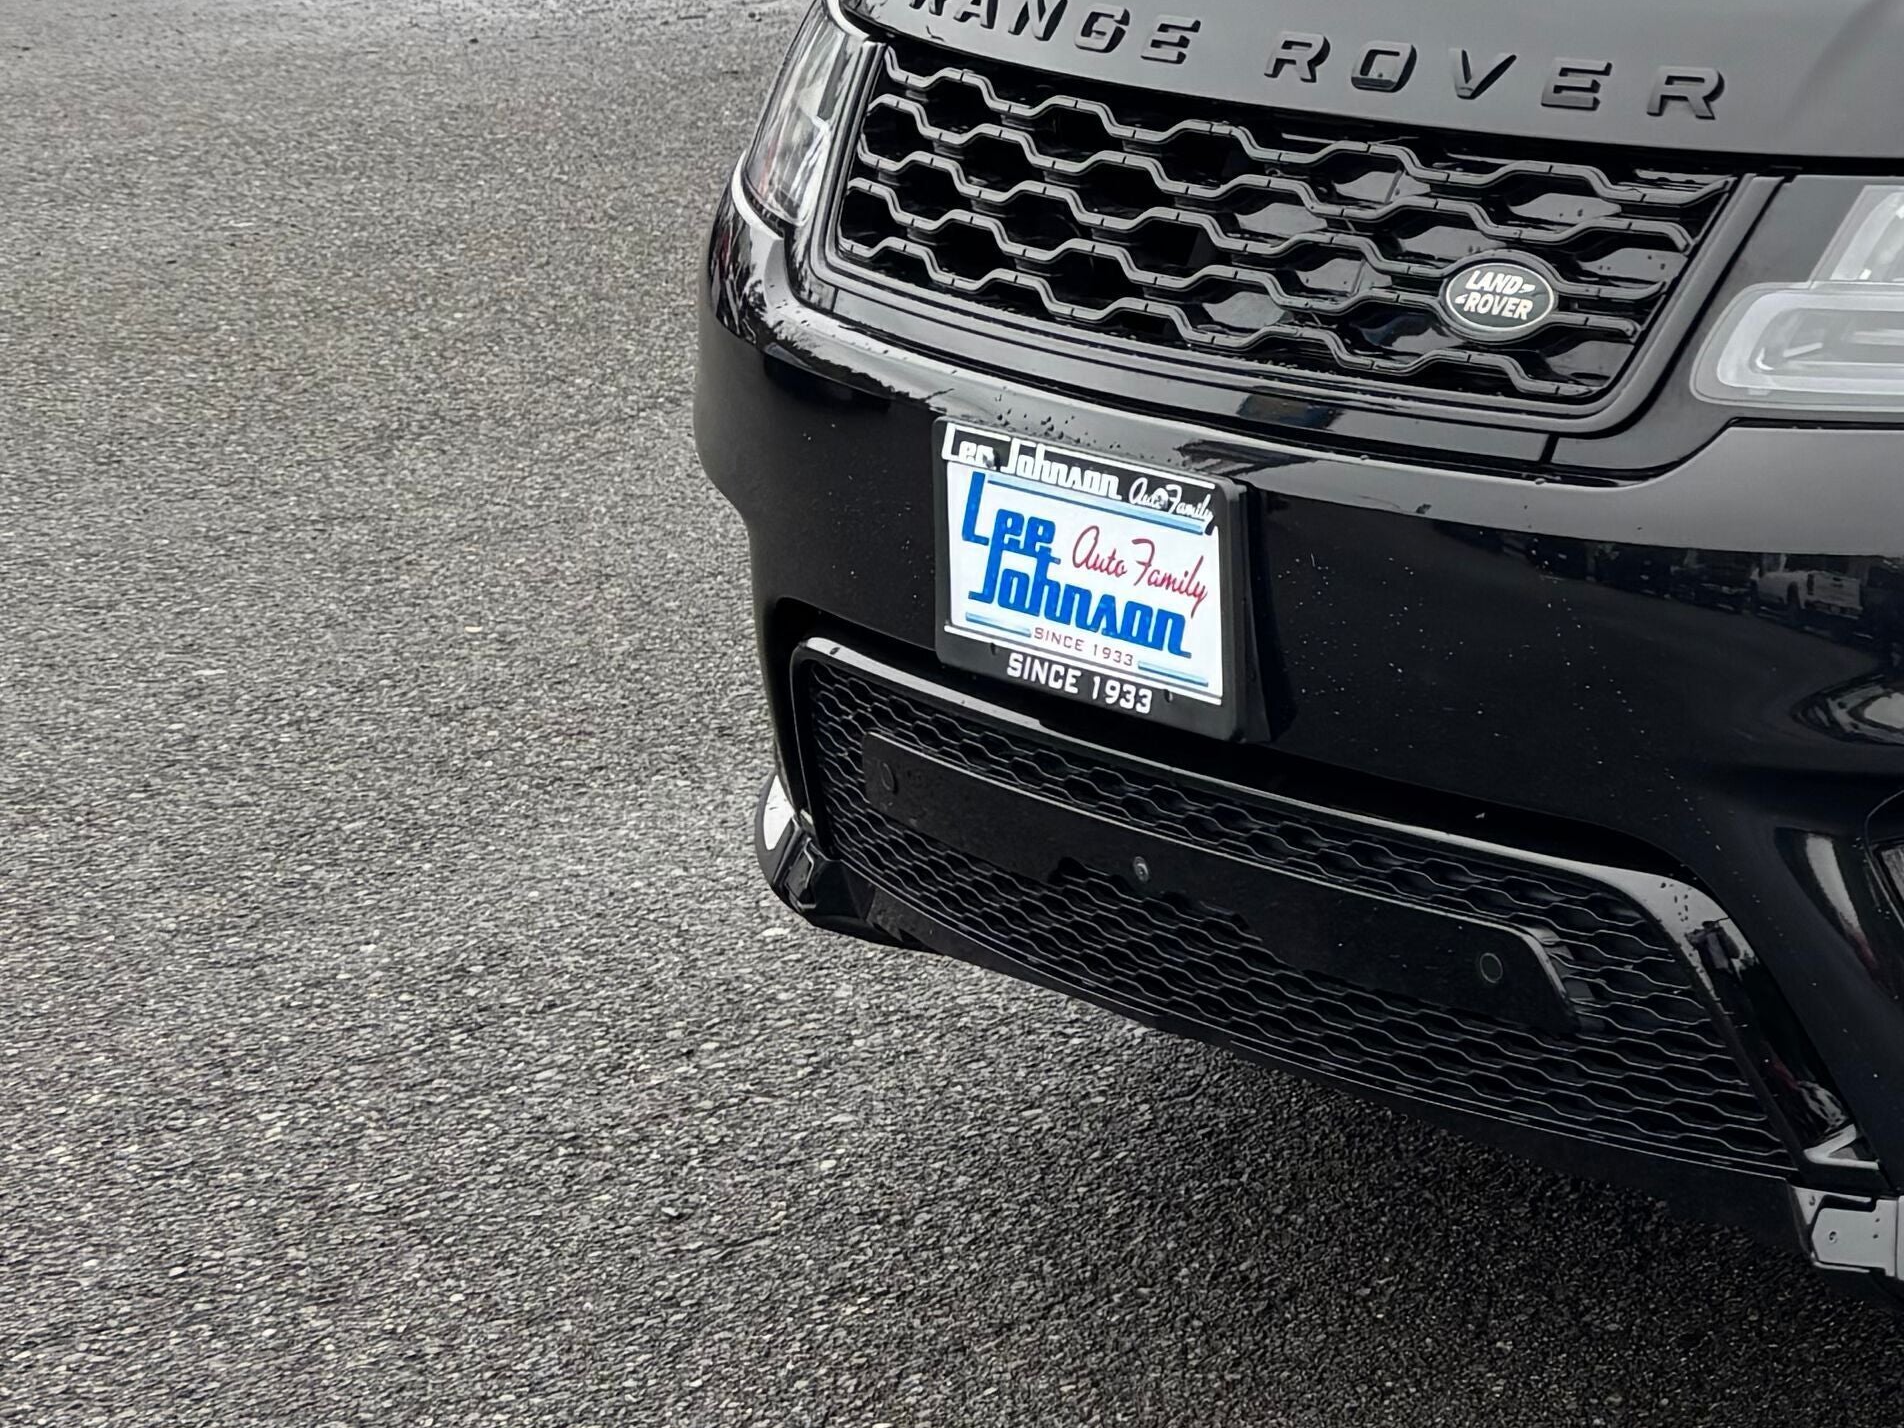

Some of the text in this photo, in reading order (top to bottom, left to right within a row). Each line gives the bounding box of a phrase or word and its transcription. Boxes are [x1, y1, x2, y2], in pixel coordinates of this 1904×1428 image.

[1264, 32, 1727, 121] ROVER
[1464, 292, 1533, 320] ROVER
[1465, 270, 1524, 295] LAND
[961, 471, 1061, 565] Lee
[1000, 436, 1122, 501] Johnson
[1164, 484, 1215, 535] Family
[968, 542, 1192, 659] Johnson
[1071, 525, 1208, 619] Auto Family
[1006, 652, 1153, 715] SINCE 1933
[1033, 626, 1134, 668] SINCE 1933
